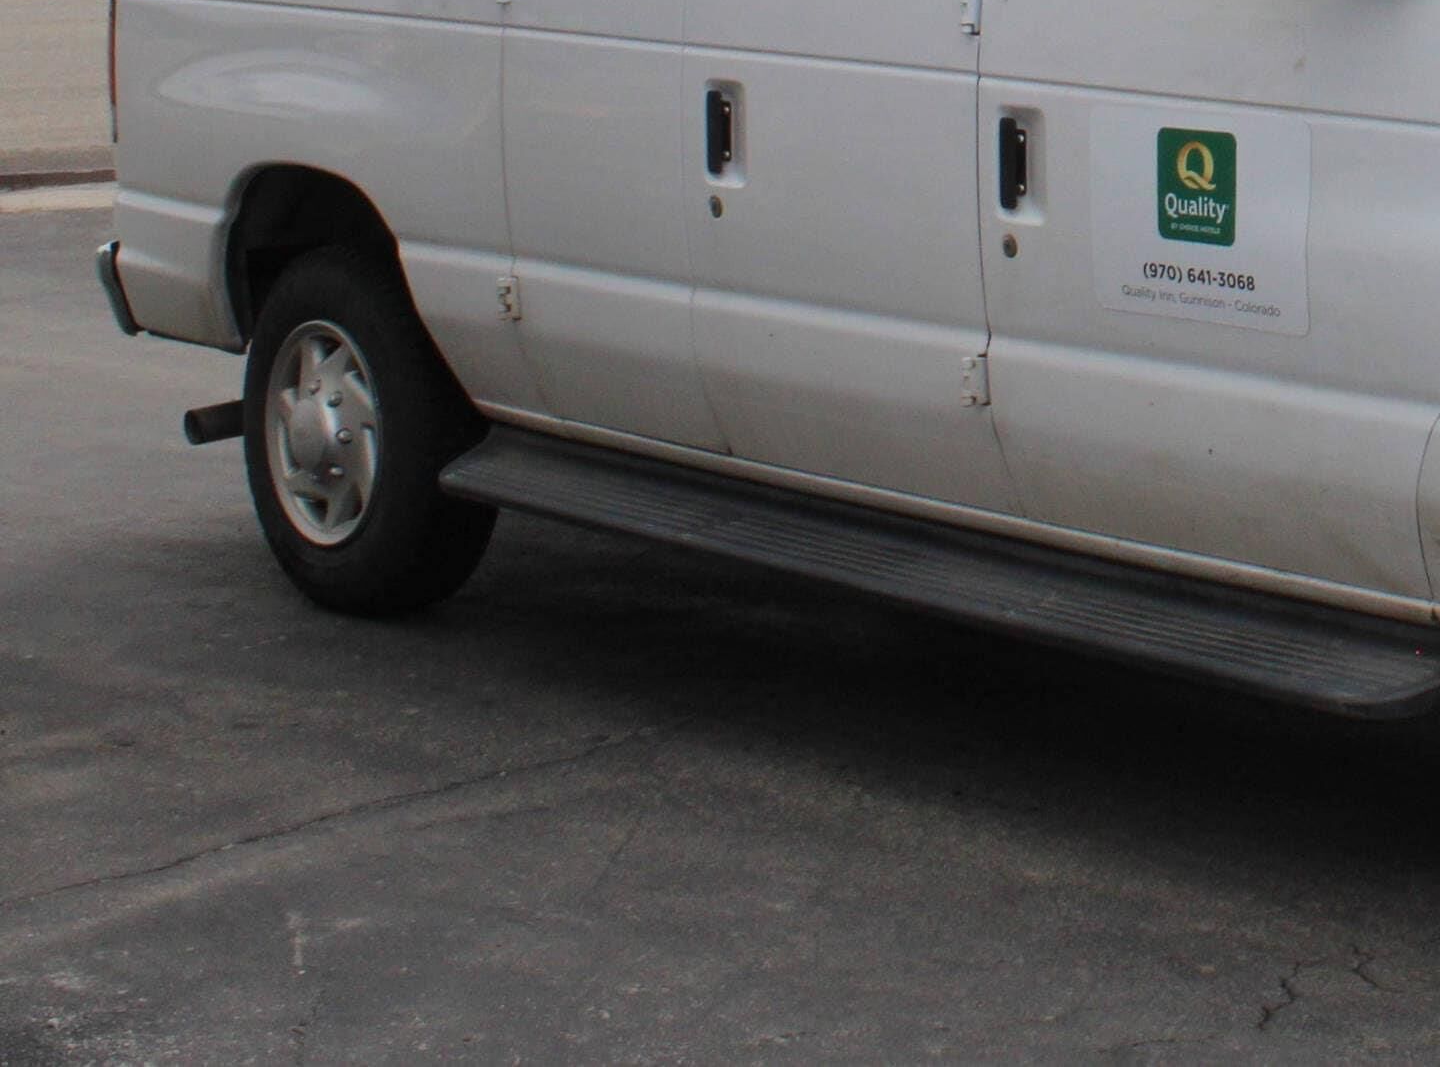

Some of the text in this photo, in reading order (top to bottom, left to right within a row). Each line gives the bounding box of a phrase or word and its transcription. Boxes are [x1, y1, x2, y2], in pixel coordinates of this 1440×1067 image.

[1177, 141, 1216, 190] Q
[1164, 193, 1226, 224] Quality
[1143, 262, 1255, 291] (970) 641-3068
[1121, 285, 1156, 302] Quality
[1235, 299, 1281, 317] Colorado
